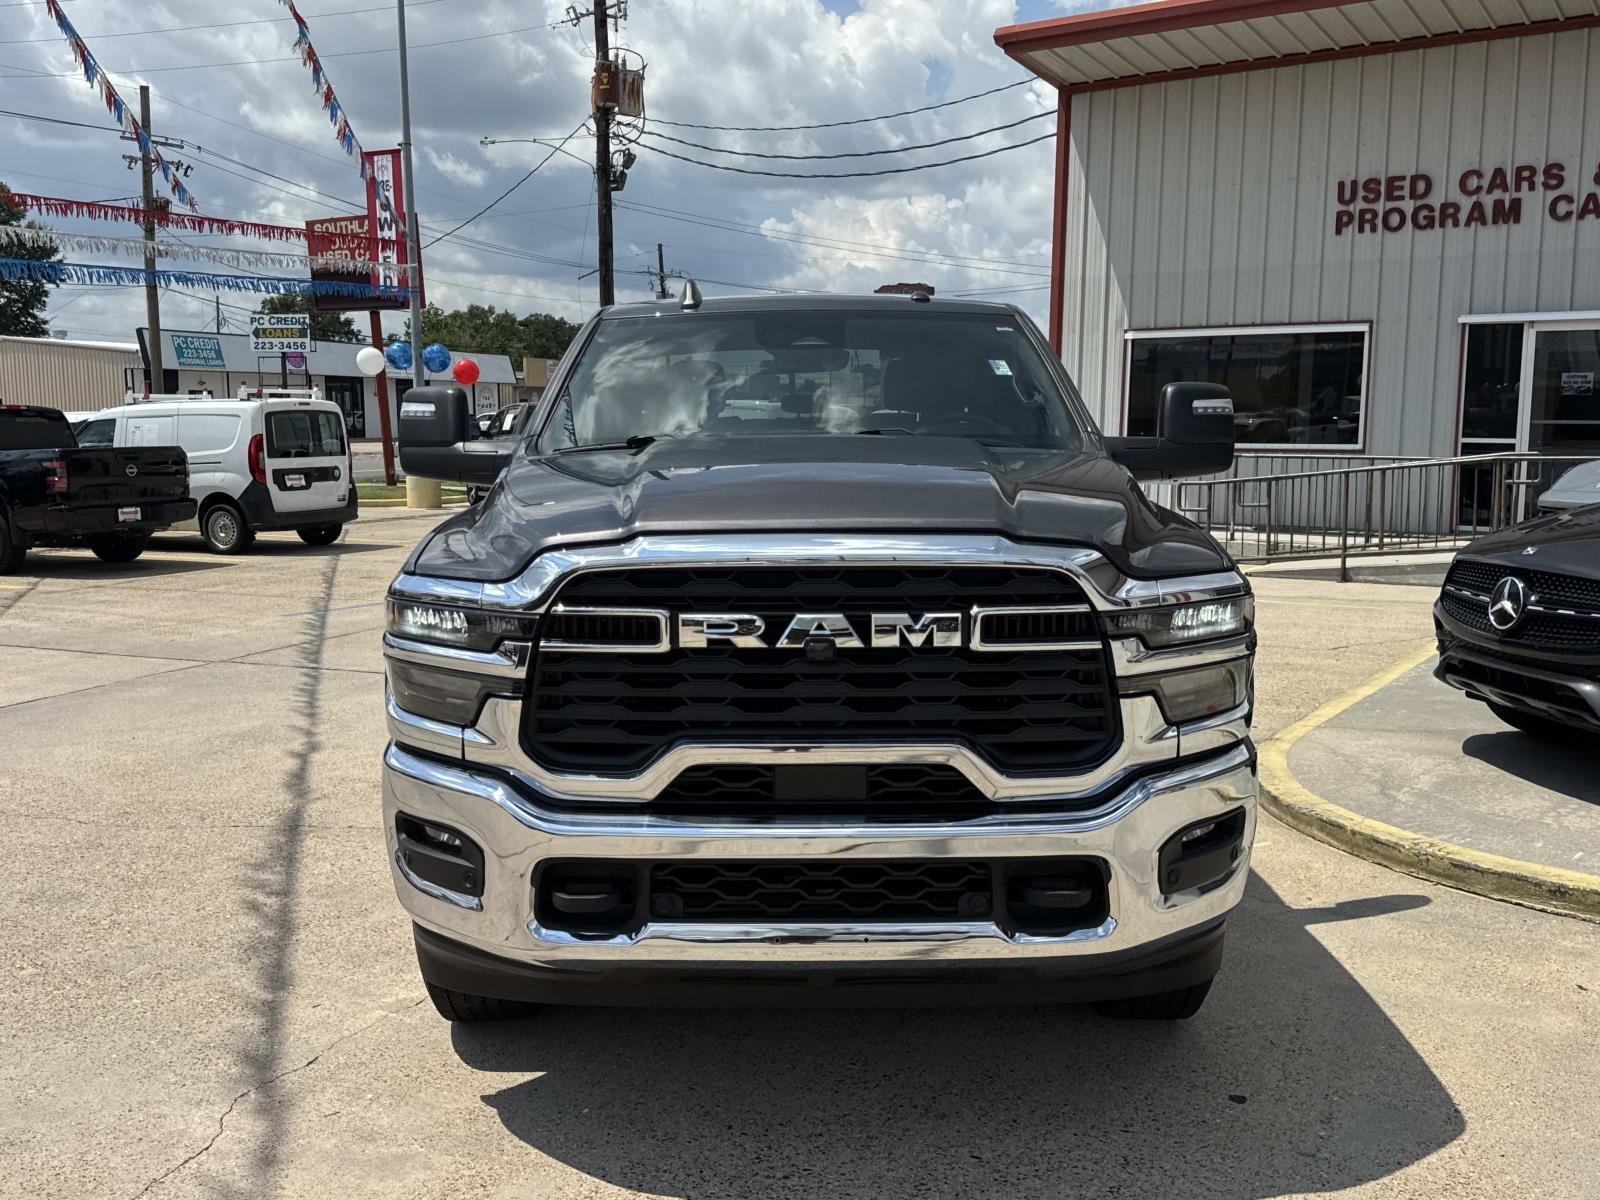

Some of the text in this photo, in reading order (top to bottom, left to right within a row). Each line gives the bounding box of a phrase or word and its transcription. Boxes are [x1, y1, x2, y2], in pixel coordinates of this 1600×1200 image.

[1337, 174, 1433, 206] USED
[1459, 163, 1565, 197] CARS
[1335, 192, 1600, 235] PROGRAM CA
[250, 316, 308, 326] PC CREDIT
[260, 328, 300, 338] LOANS
[173, 336, 219, 350] PC CREDIT
[254, 341, 307, 350] 223-3456
[679, 613, 962, 648] RAM
